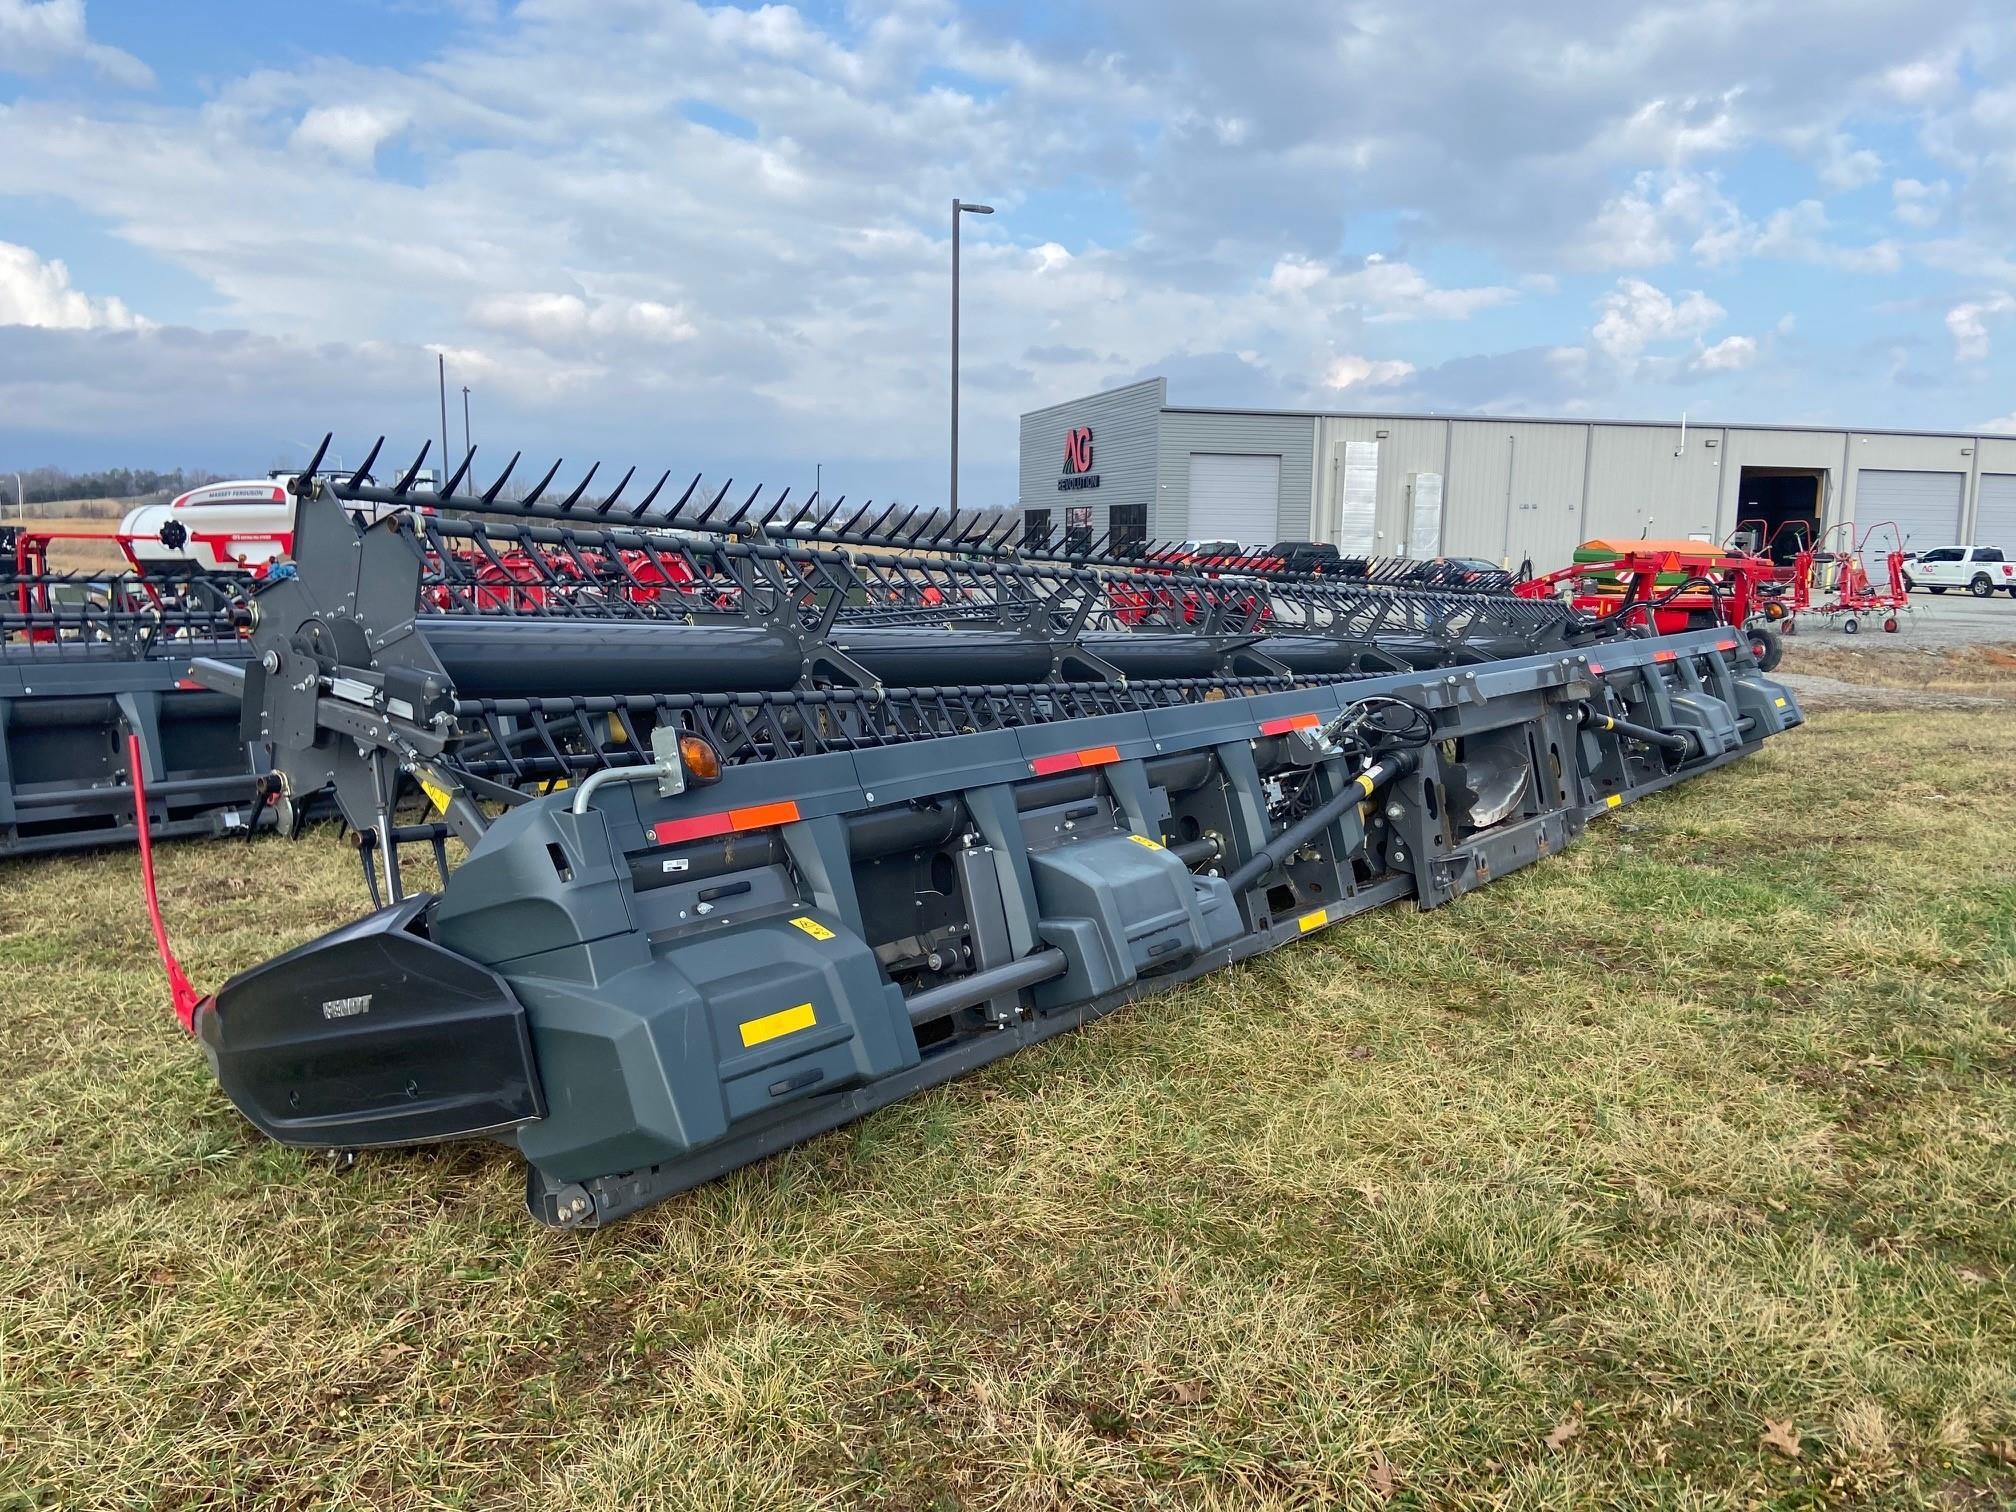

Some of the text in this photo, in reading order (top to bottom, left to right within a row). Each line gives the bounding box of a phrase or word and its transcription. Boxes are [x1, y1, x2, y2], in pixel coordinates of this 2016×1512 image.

[1063, 426, 1093, 474] AG
[1057, 475, 1100, 491] REVOLUTION
[1922, 565, 1934, 573] AG
[322, 994, 373, 1020] FENDT
